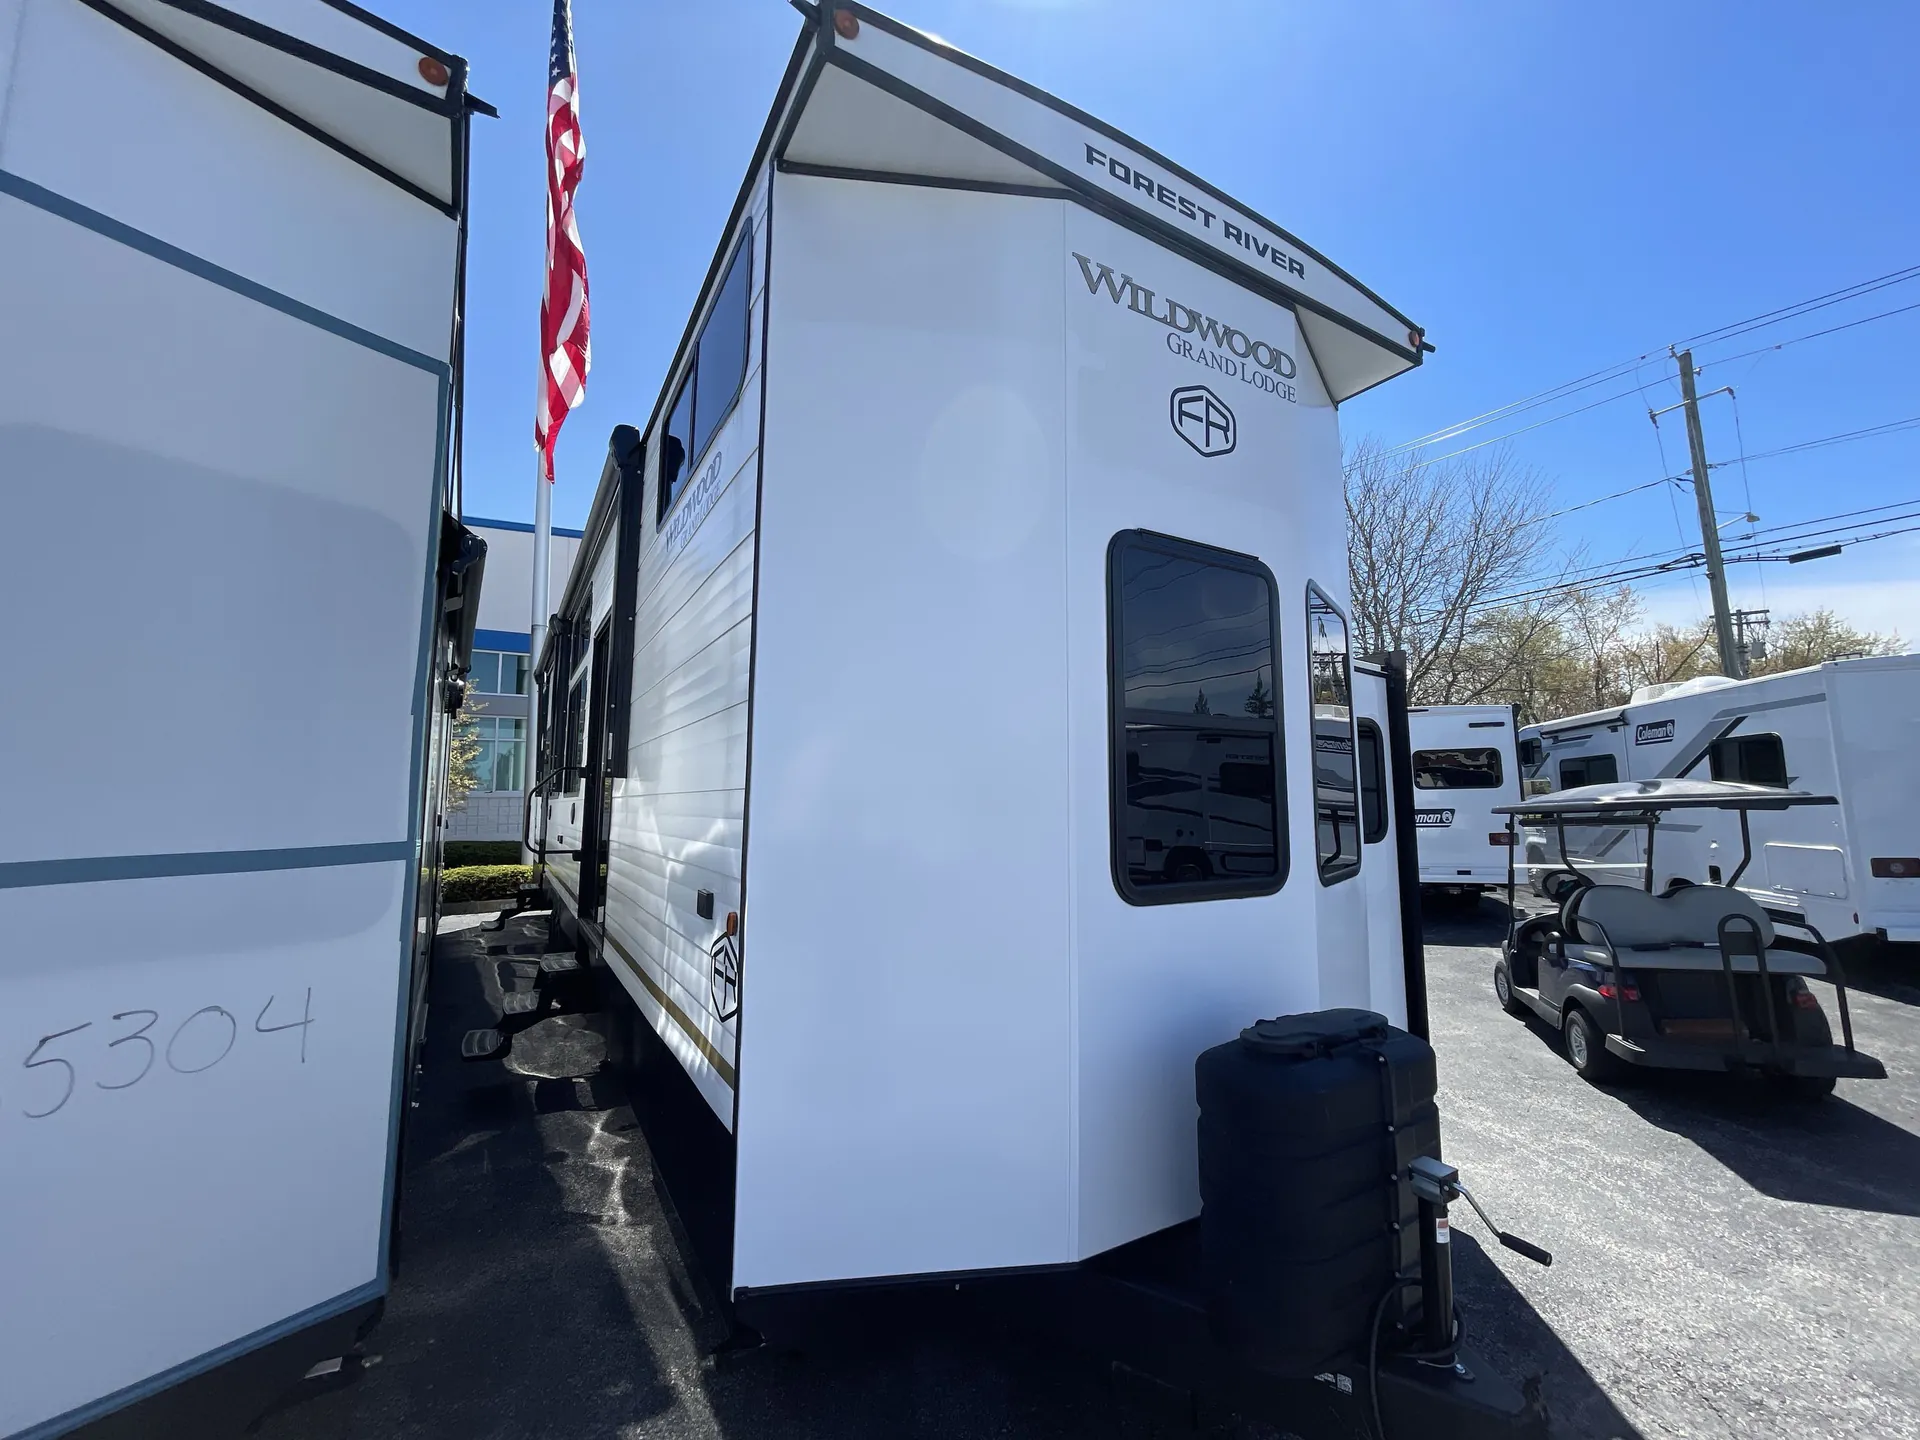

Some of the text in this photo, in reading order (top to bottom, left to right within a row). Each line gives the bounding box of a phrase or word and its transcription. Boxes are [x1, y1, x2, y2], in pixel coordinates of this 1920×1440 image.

[1084, 142, 1306, 281] FOREST RIVER
[1072, 251, 1297, 380] WILDWOOD
[1166, 332, 1297, 404] GRAND LODGE
[1637, 725, 1667, 741] Coleman
[23, 986, 315, 1119] 5304
